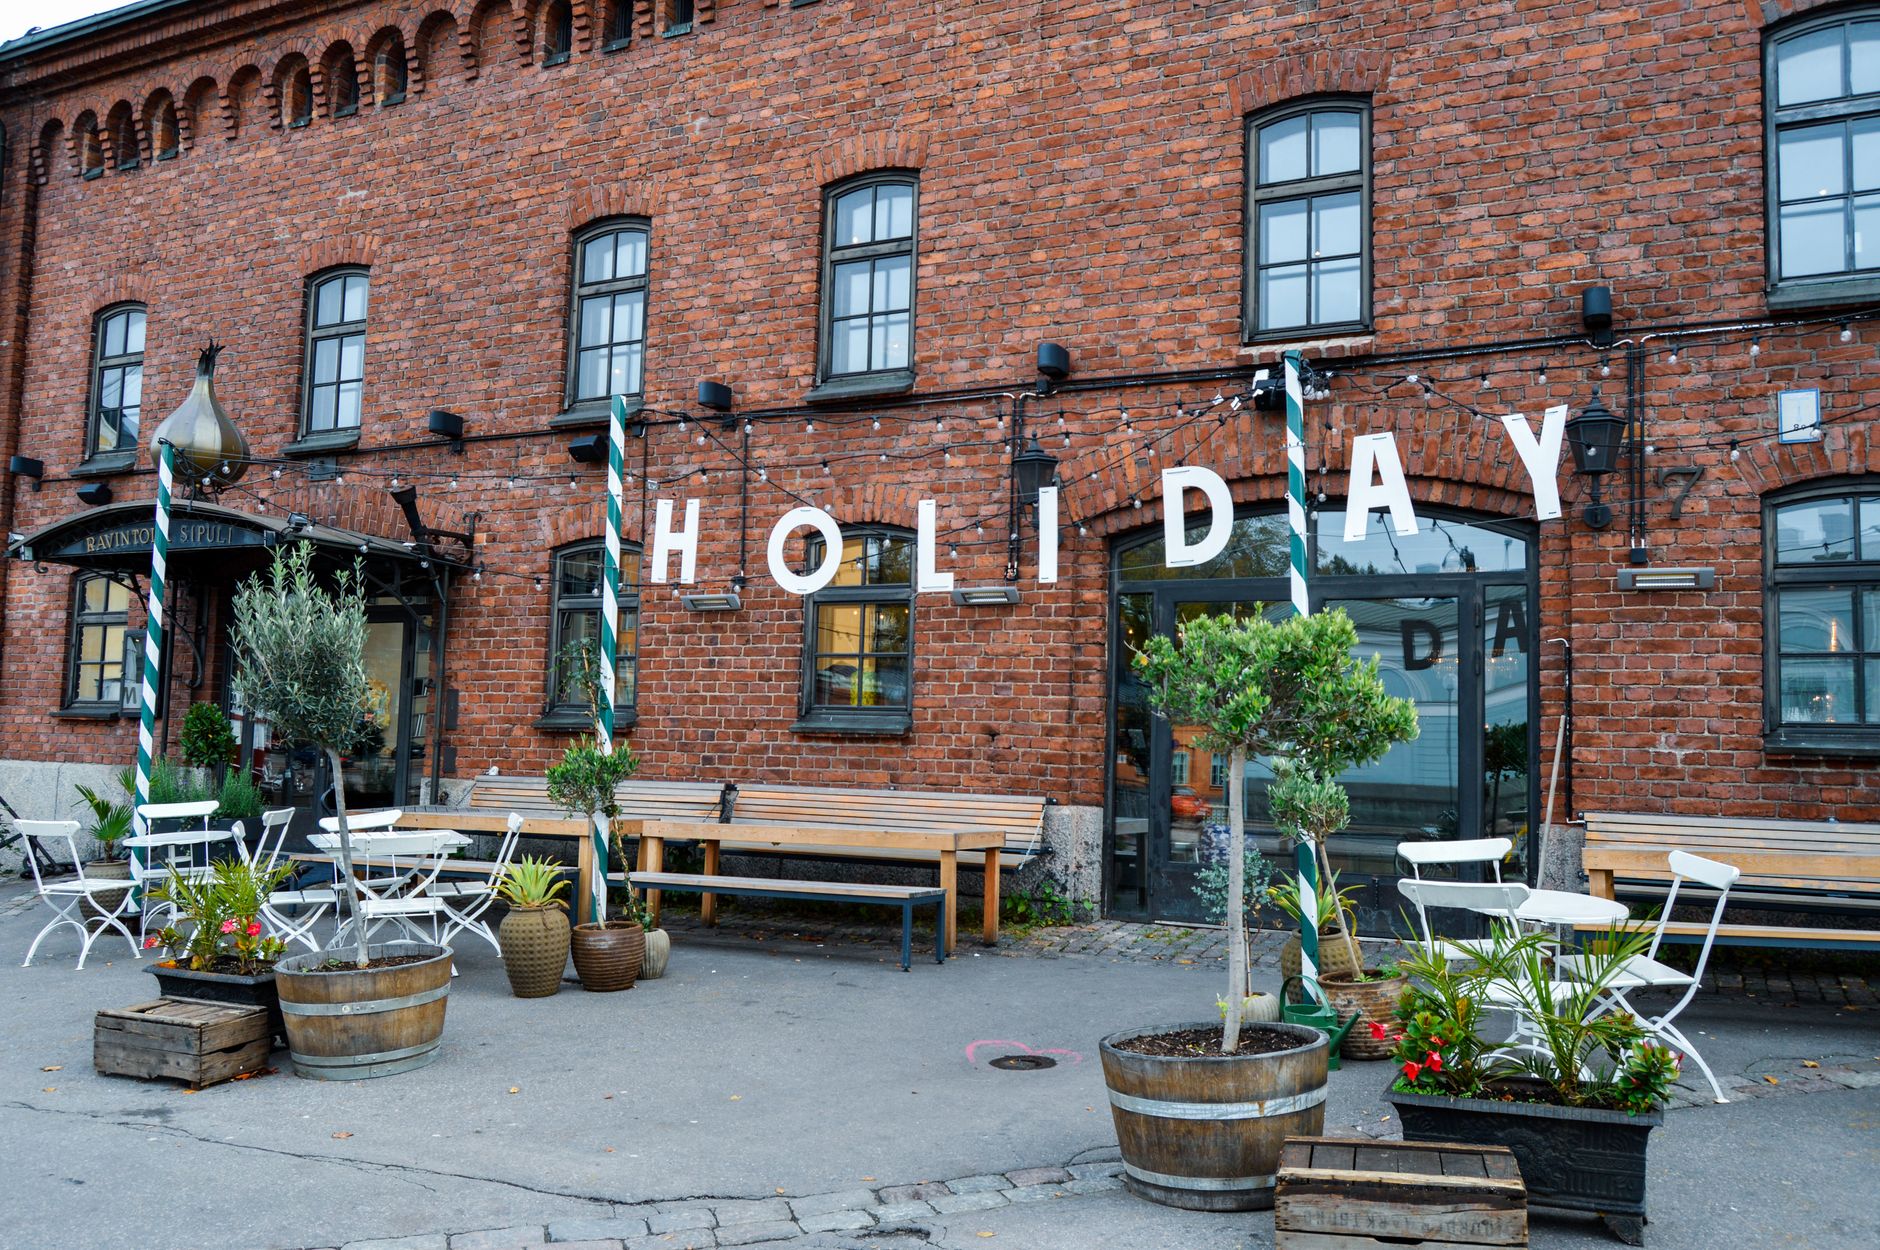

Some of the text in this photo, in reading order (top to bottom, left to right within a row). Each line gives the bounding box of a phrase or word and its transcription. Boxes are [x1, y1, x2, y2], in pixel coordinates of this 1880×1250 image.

[651, 404, 1568, 595] HOLIDAY
[1657, 465, 1704, 520] 7
[86, 523, 233, 553] RAVINTOL SIPULI
